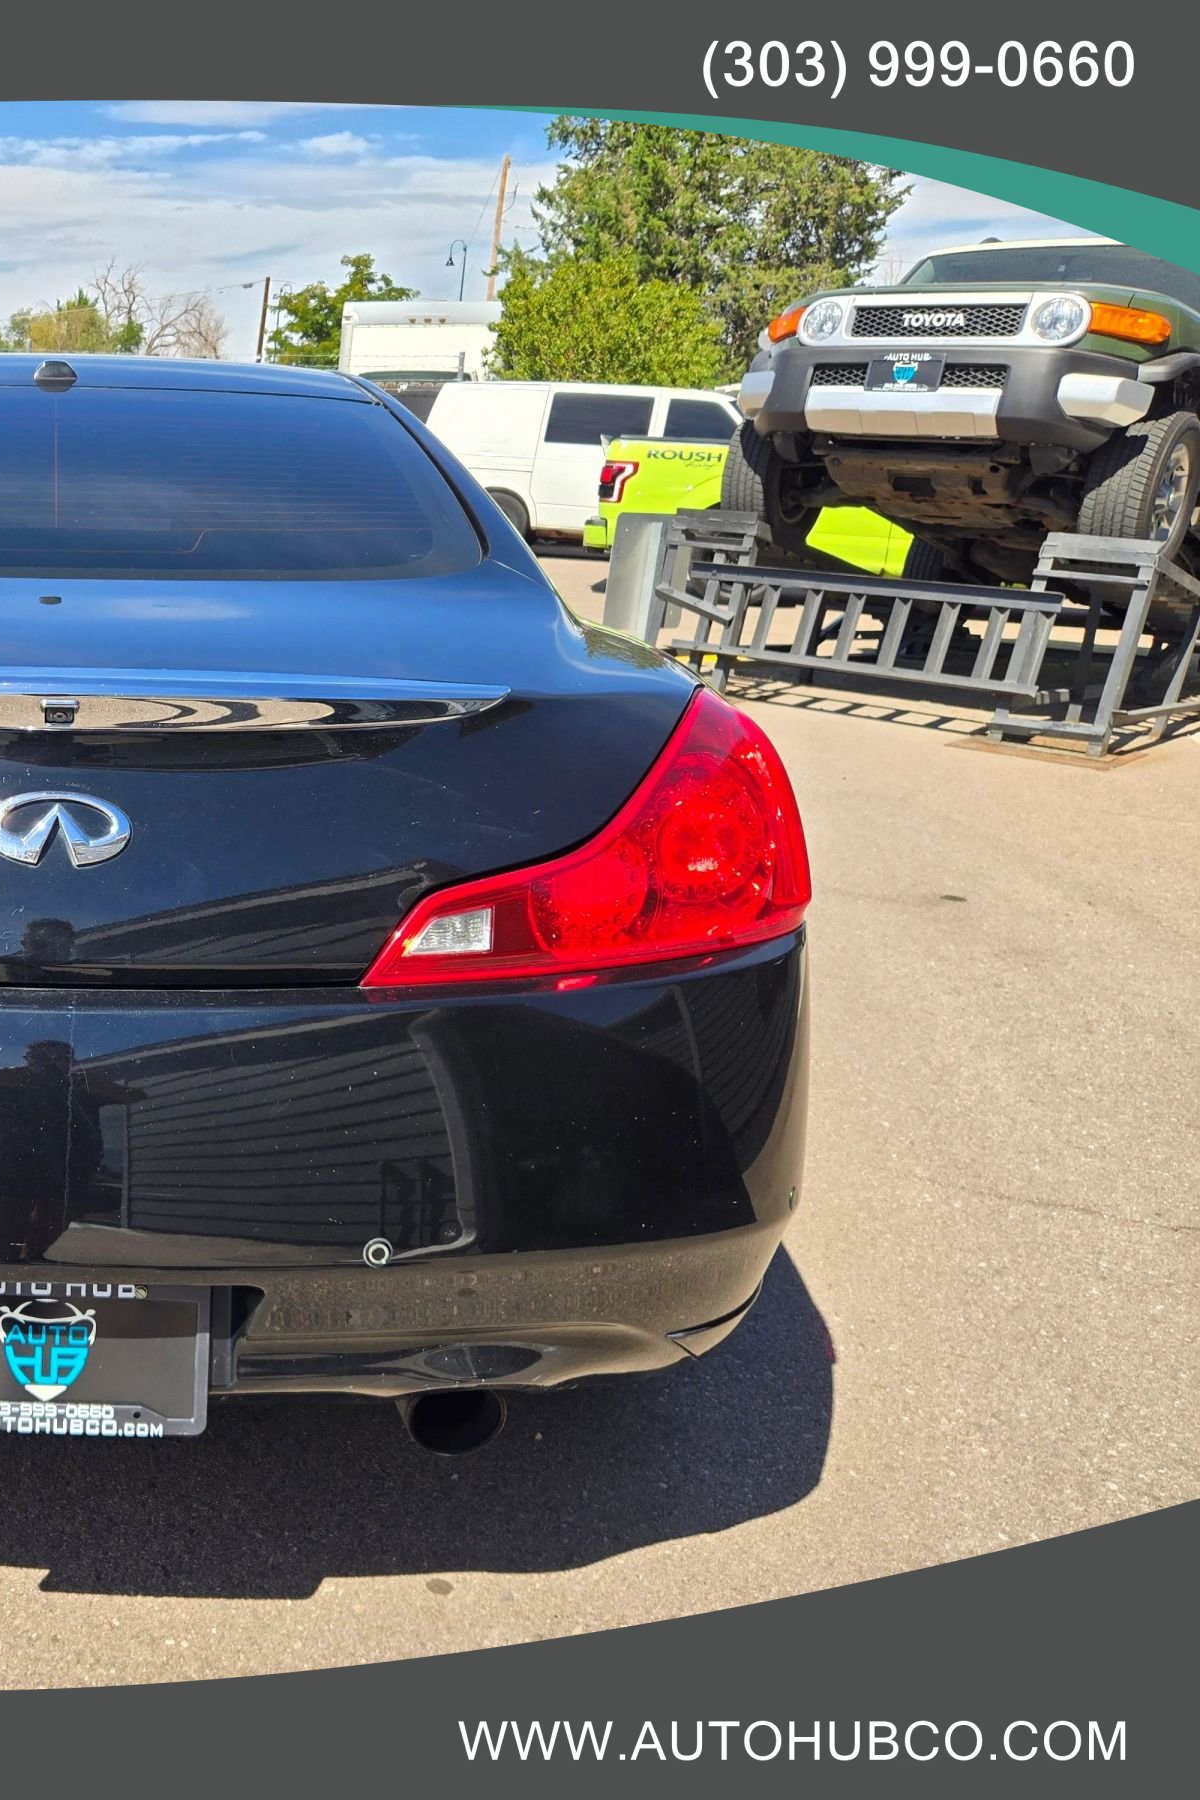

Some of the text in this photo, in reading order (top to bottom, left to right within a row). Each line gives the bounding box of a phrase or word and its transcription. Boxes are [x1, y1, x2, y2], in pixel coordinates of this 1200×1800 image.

[902, 313, 965, 327] TOYOTA
[647, 449, 723, 462] ROUSH
[4, 1324, 89, 1345] AUTO
[4, 1345, 89, 1386] HUB
